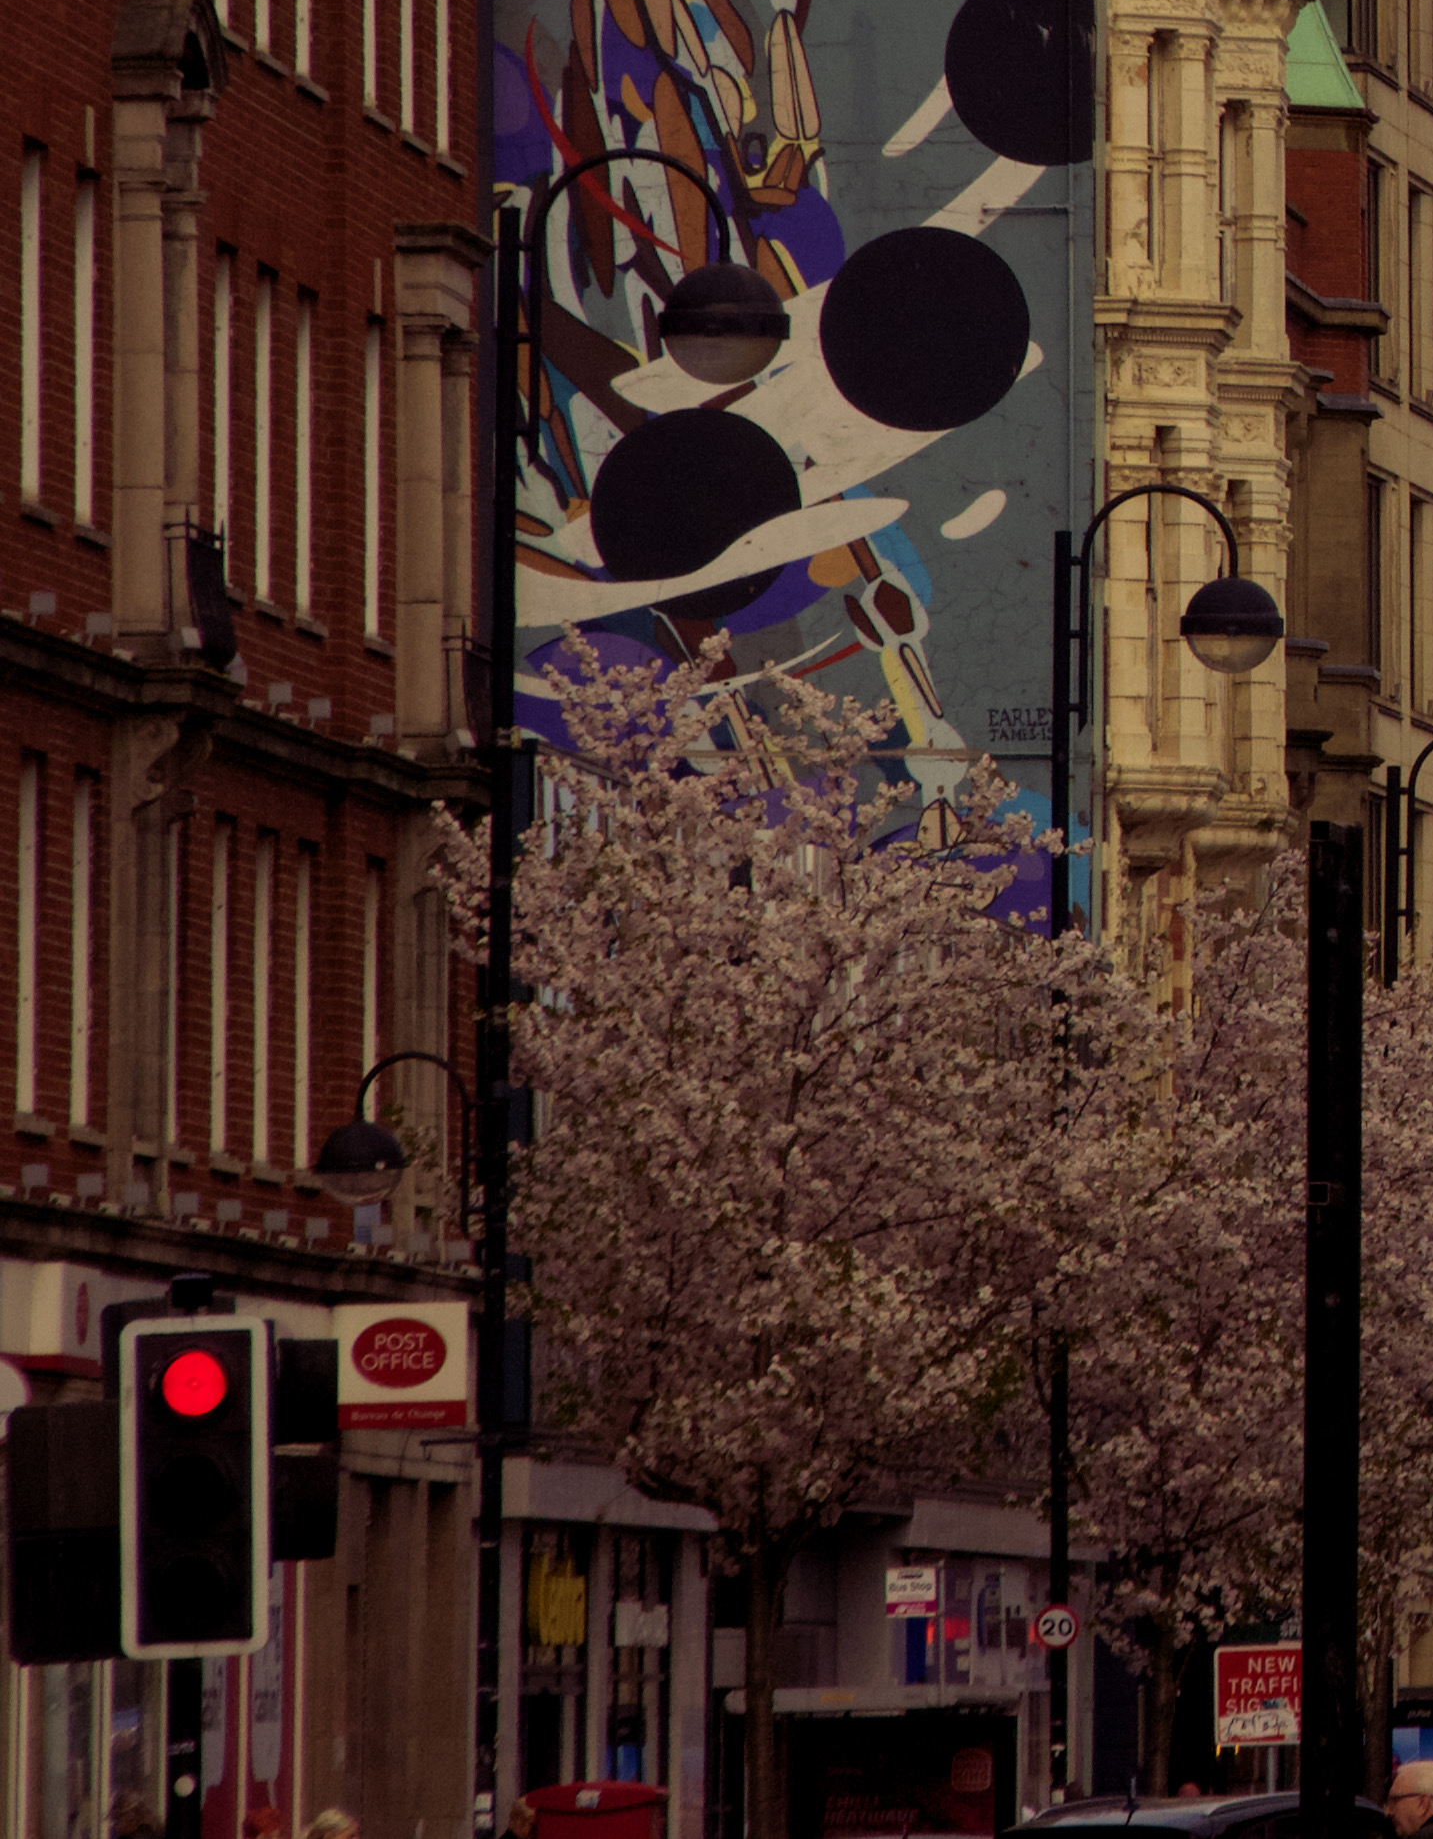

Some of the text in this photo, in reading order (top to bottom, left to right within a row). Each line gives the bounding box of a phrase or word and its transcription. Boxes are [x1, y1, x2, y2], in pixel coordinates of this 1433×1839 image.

[374, 1331, 428, 1351] POST
[360, 1348, 436, 1372] OFFICE
[909, 1581, 932, 1593] Stop
[1042, 1618, 1073, 1636] 20
[1246, 1654, 1297, 1675] NEW
[1227, 1675, 1300, 1695] TRAFFI
